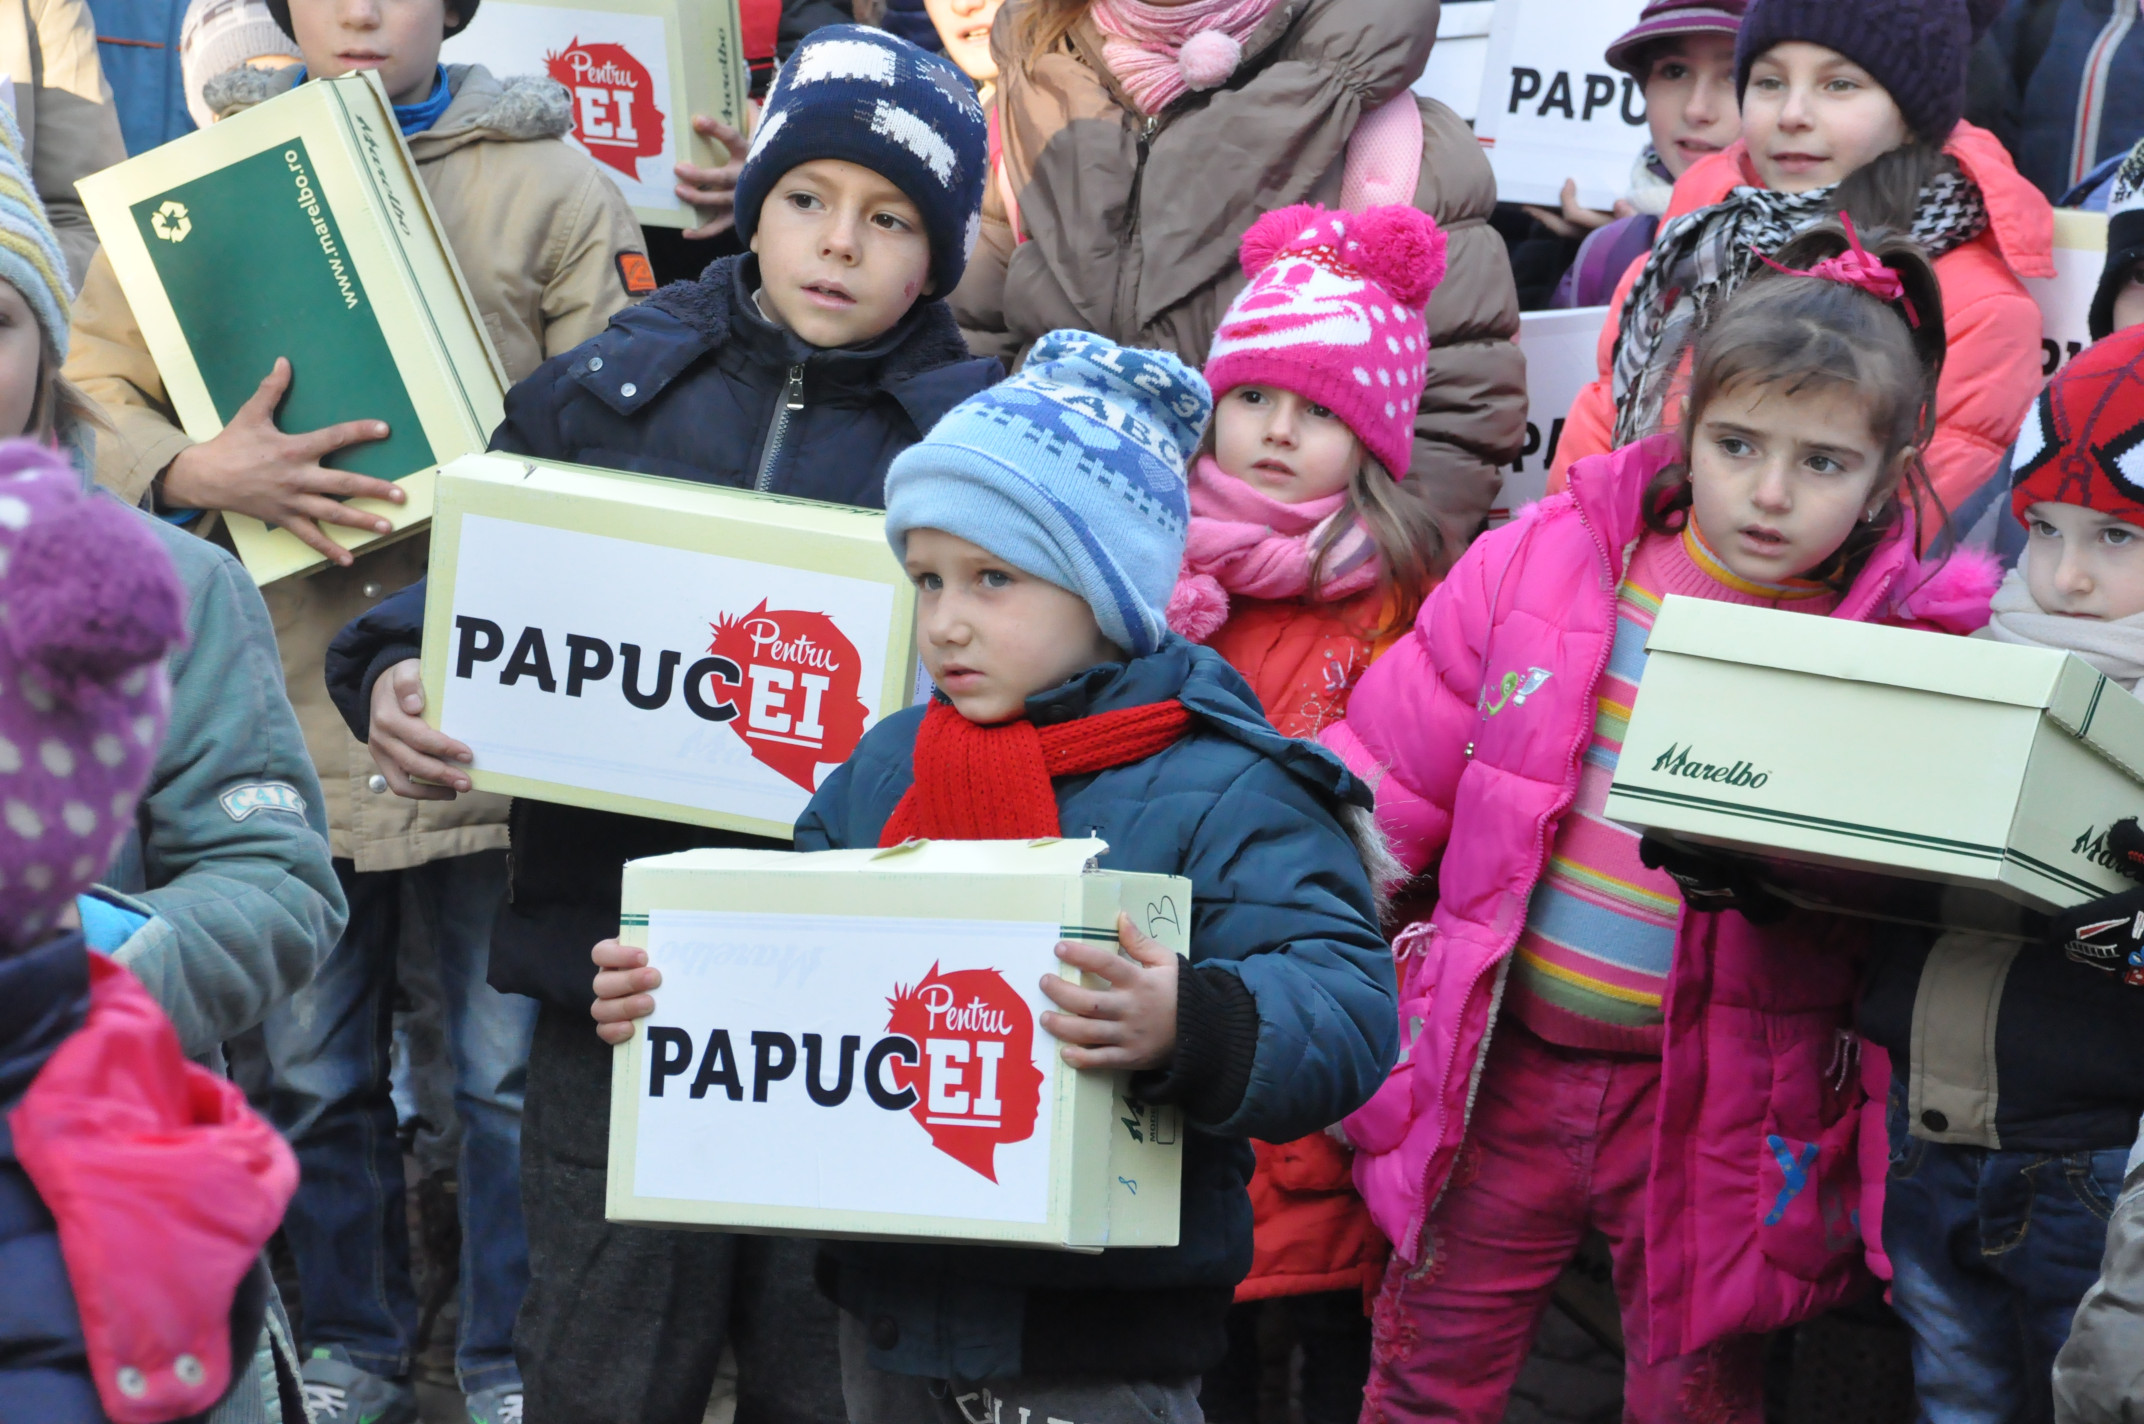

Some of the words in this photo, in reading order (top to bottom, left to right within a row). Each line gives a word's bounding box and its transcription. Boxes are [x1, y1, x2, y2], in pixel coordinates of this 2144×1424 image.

[565, 50, 638, 88] Pentru
[284, 149, 359, 310] www.marelbo.ro
[743, 618, 840, 672] Pentru
[1651, 742, 1769, 789] Marelbo
[917, 984, 1013, 1036] Pentru
